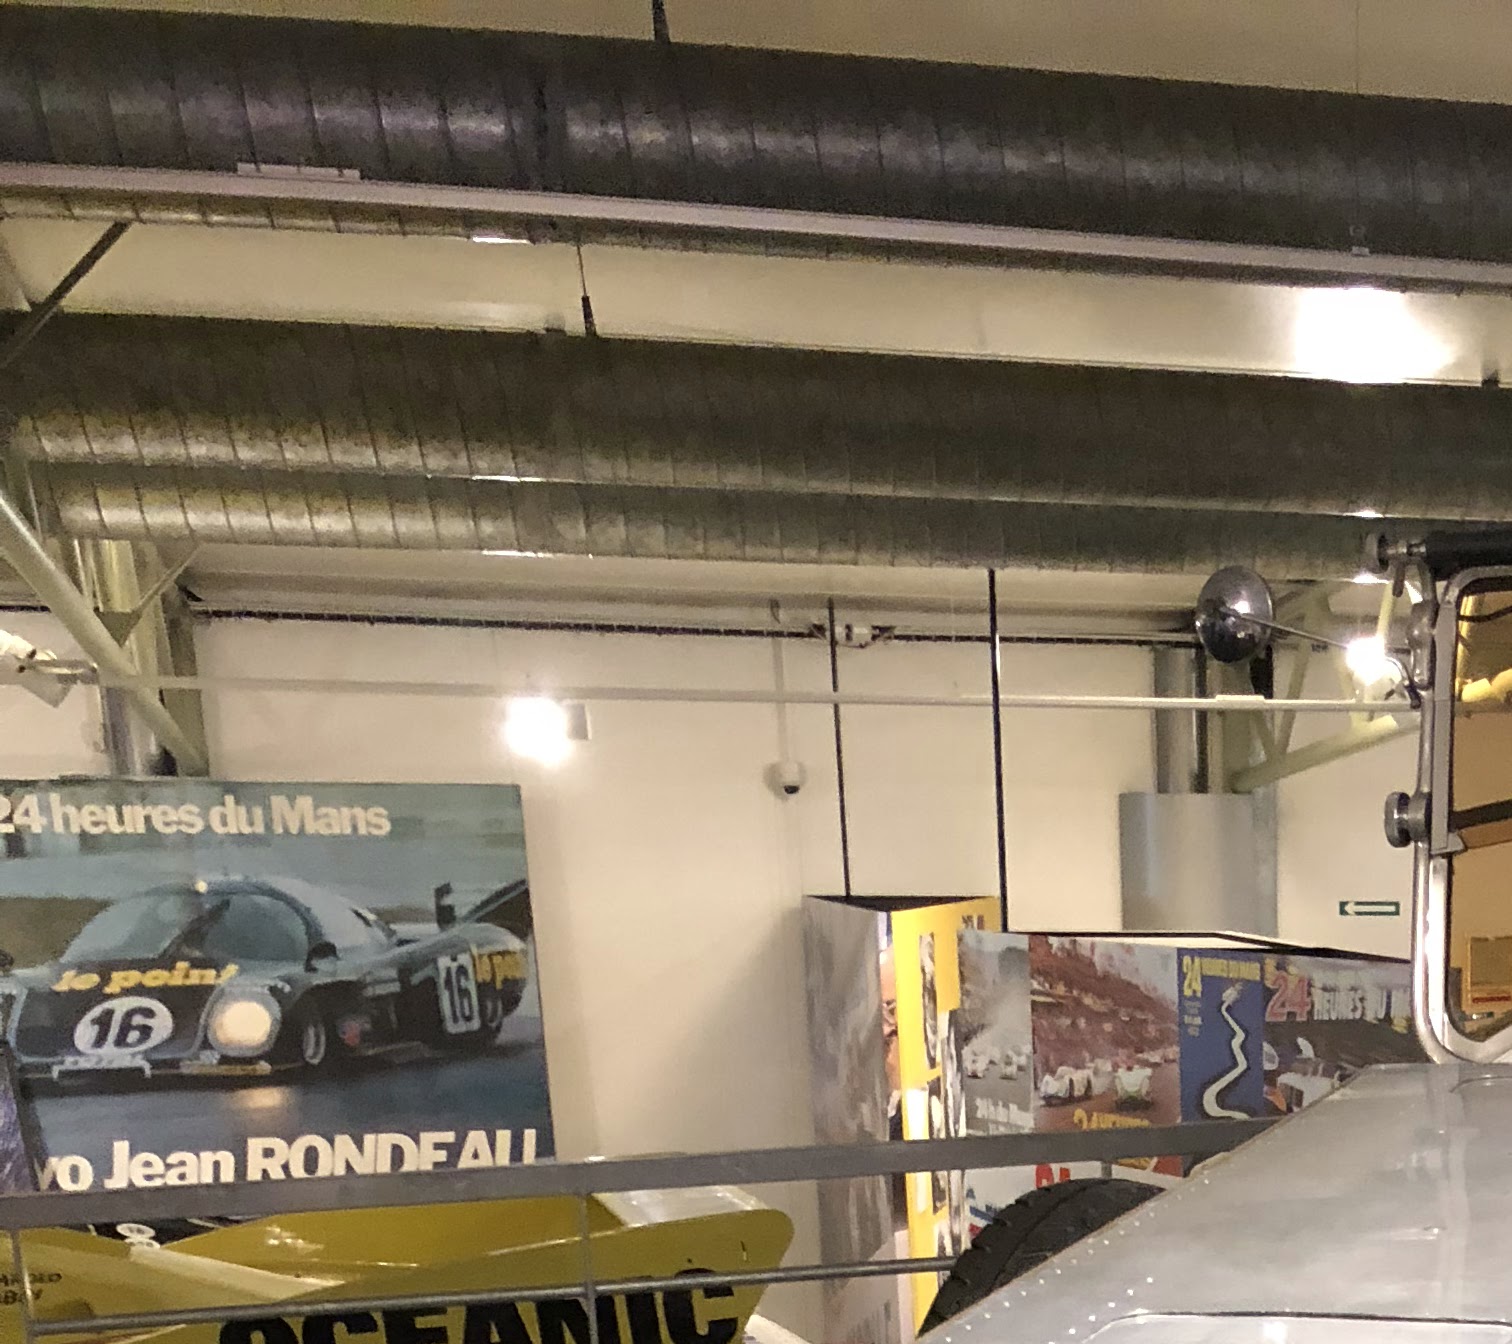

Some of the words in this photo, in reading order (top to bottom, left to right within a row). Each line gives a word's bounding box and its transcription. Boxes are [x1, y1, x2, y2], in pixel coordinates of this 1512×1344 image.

[0, 794, 47, 834] 24
[49, 793, 203, 835] heures
[209, 794, 265, 835] du
[270, 795, 391, 836] Mans
[444, 964, 473, 1024] 16
[1265, 970, 1311, 1022] 24
[90, 1007, 156, 1048] 16
[104, 1140, 234, 1190] Jean
[246, 1128, 536, 1181] RONDEAU
